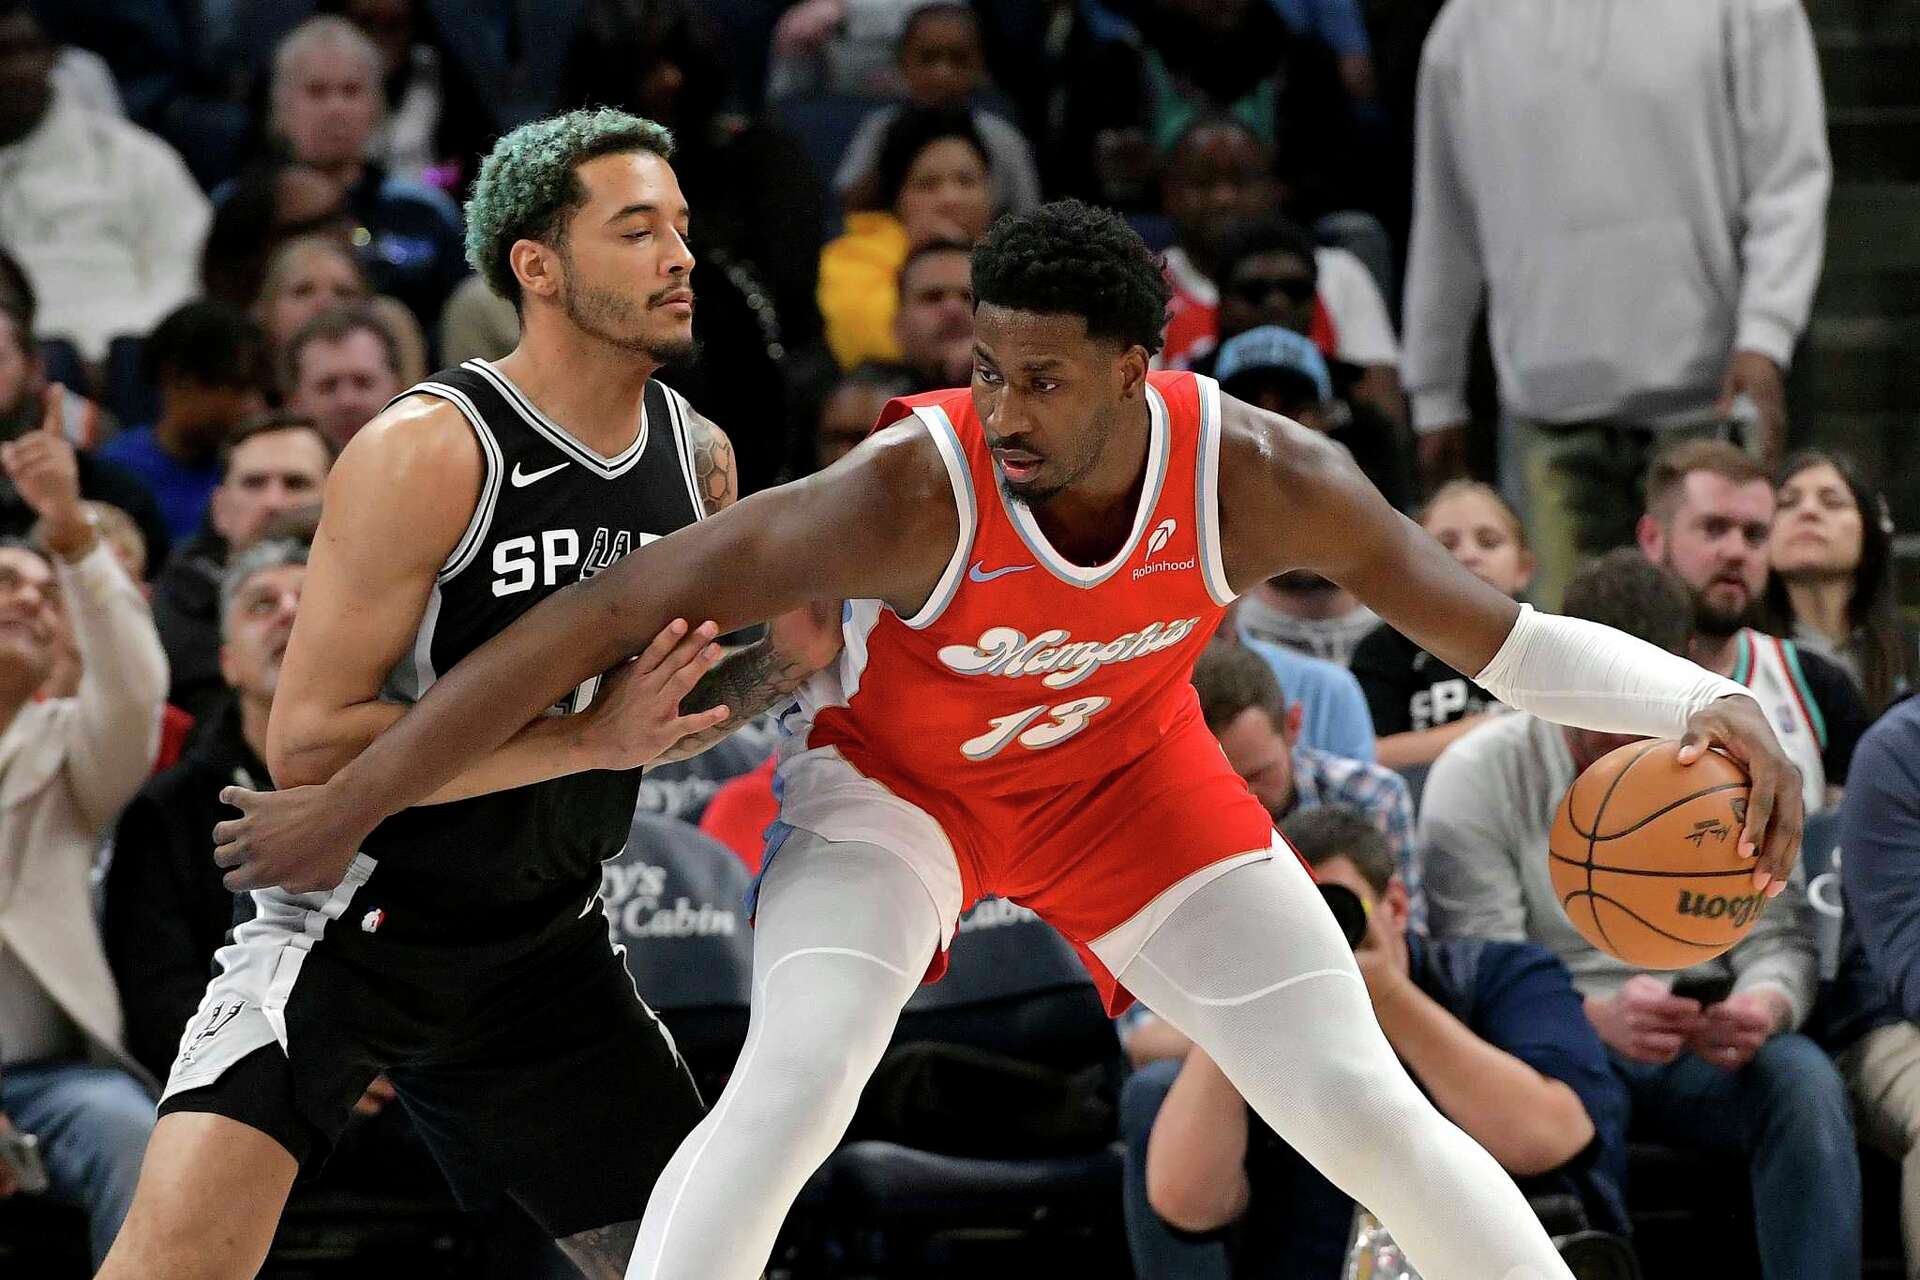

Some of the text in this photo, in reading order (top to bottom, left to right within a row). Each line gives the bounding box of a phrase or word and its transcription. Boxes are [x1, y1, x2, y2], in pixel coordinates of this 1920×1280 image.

[1132, 558, 1195, 581] Robinhood
[937, 617, 1200, 690] Memphis
[960, 696, 1112, 762] 13
[623, 896, 736, 938] Cabin
